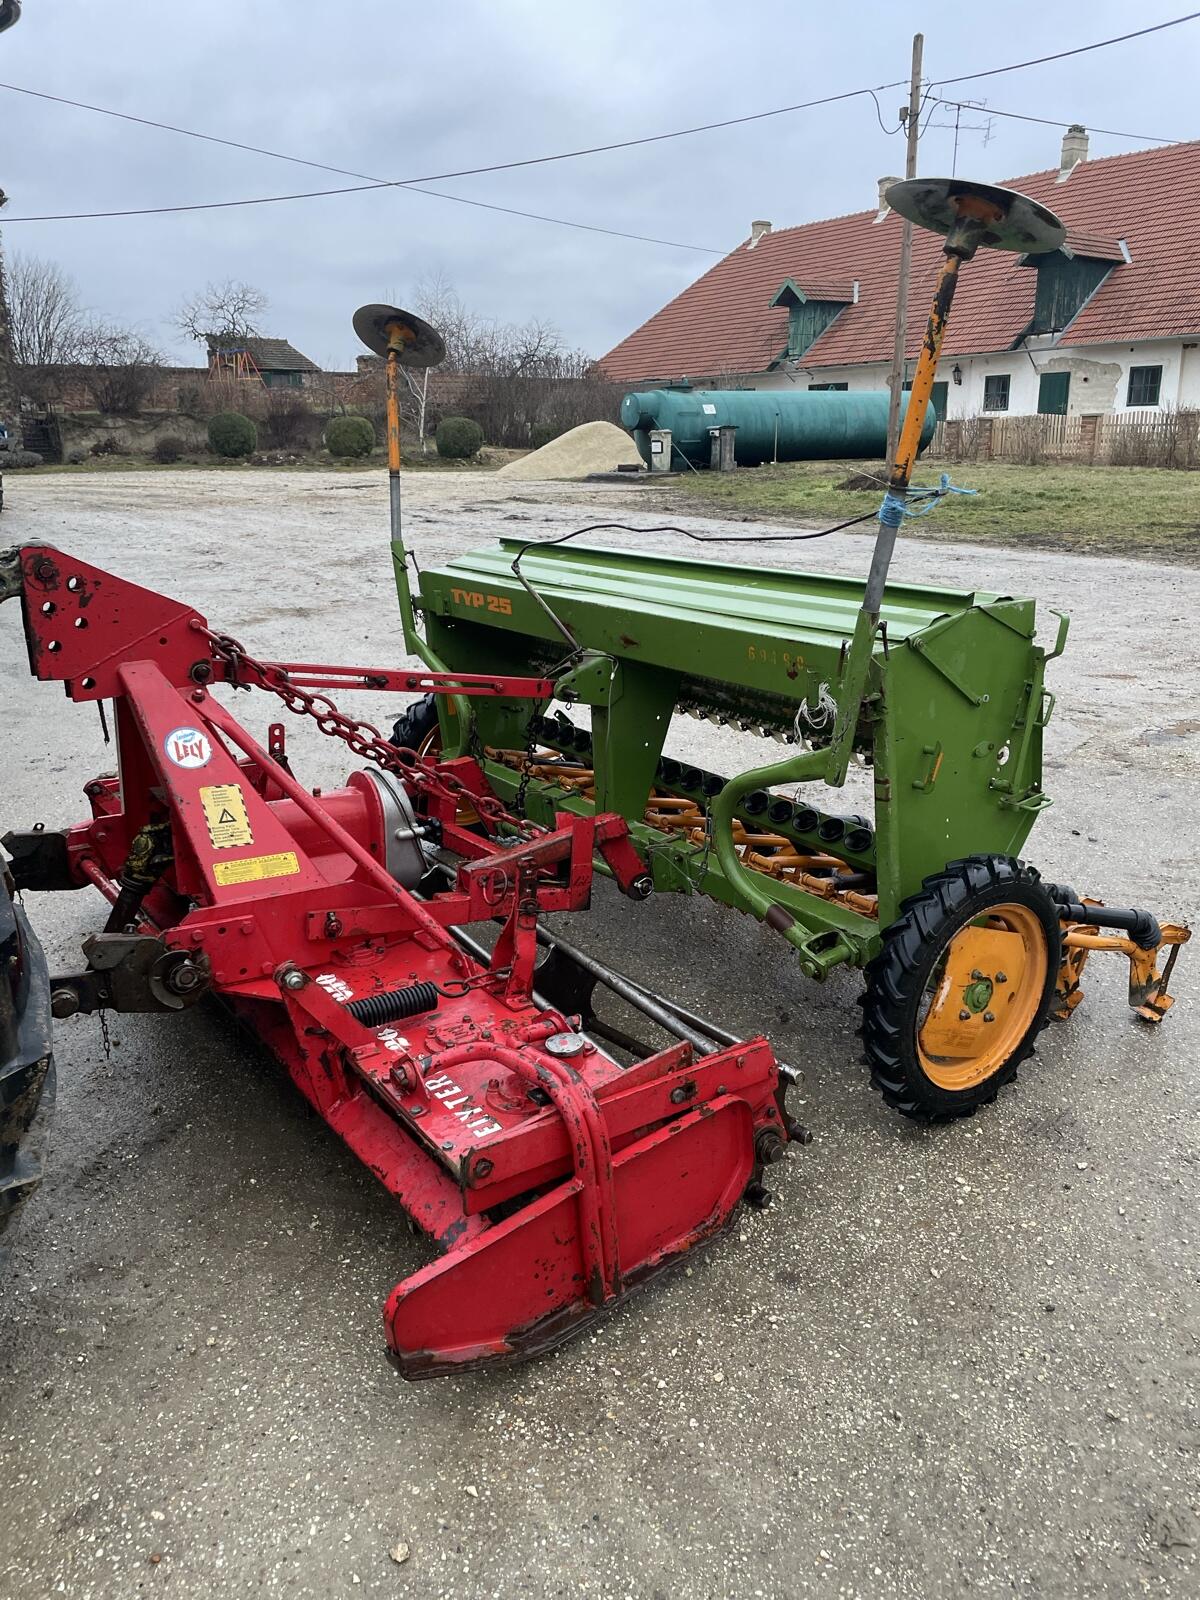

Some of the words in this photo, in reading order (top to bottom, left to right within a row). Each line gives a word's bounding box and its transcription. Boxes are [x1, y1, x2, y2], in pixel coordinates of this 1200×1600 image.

[450, 588, 485, 608] TYP
[487, 594, 512, 615] 25
[174, 740, 204, 763] LELY
